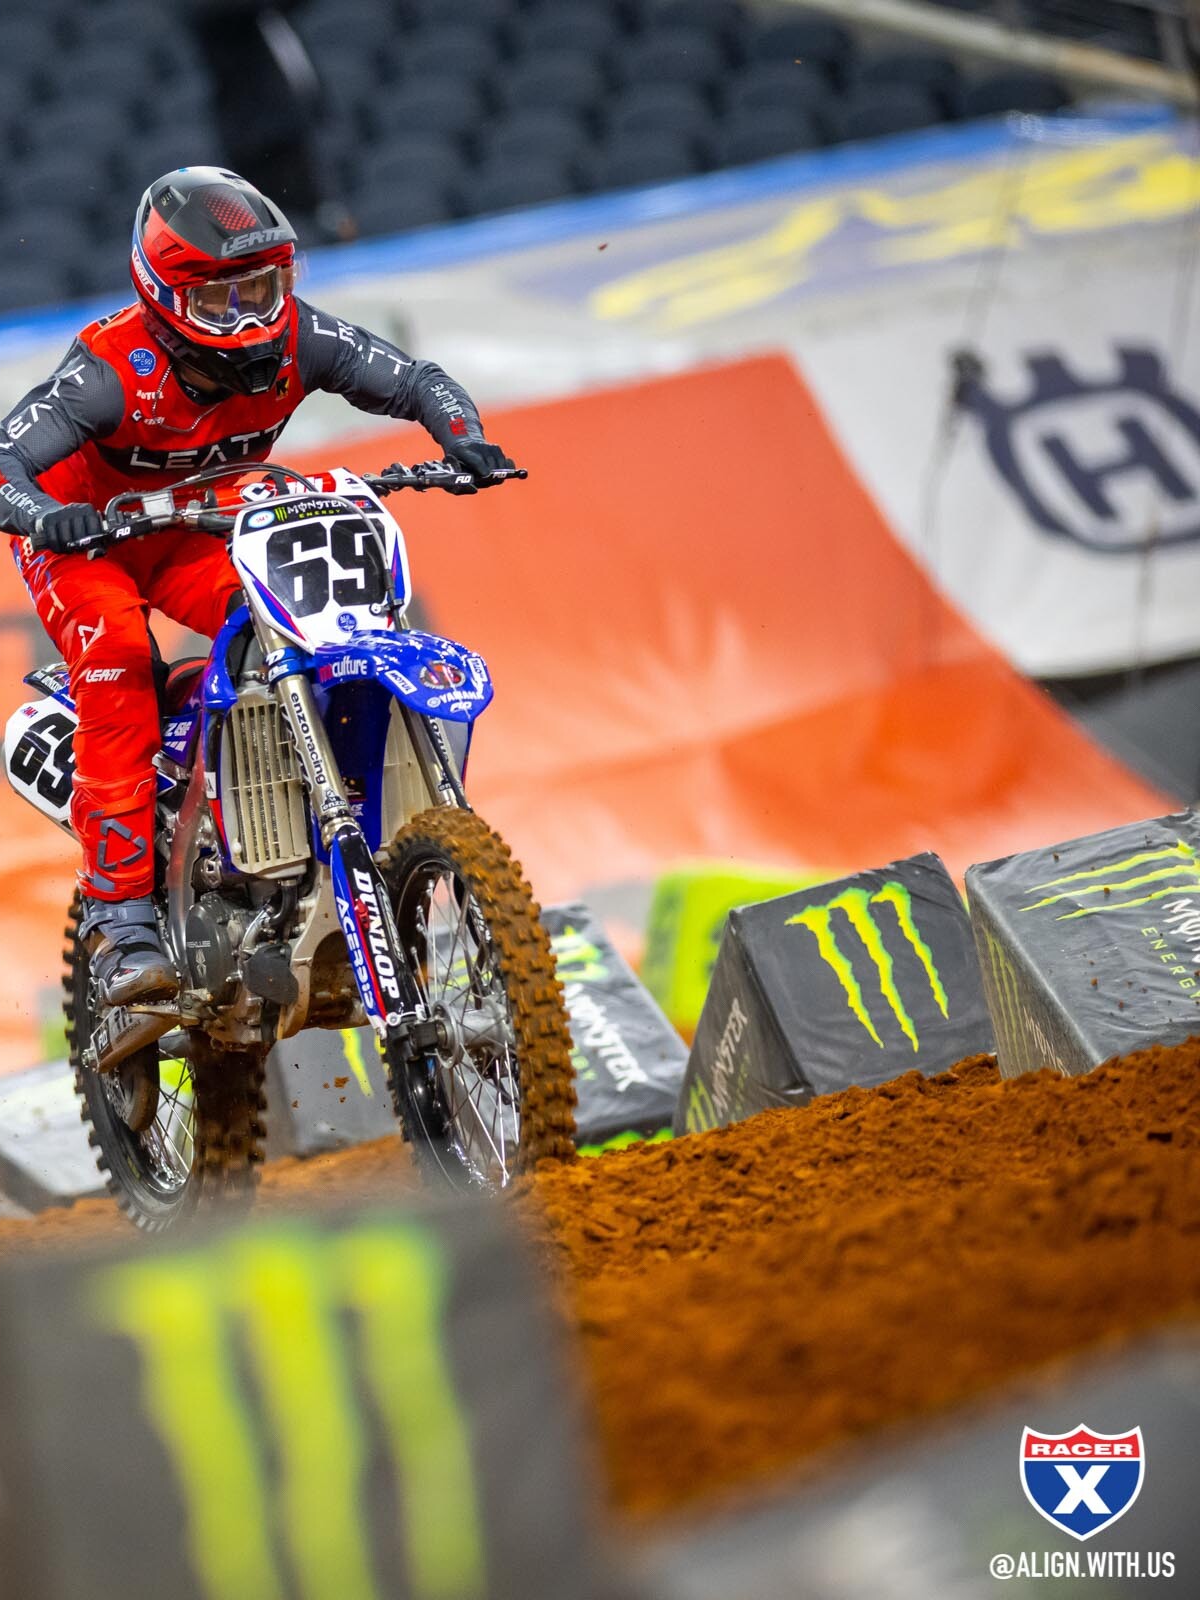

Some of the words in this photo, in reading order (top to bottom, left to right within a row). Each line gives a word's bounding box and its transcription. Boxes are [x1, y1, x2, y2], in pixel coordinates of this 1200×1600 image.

[221, 229, 286, 257] LEATT
[455, 475, 472, 484] FLO
[287, 499, 347, 515] MONSTER
[298, 509, 341, 518] ENERGY
[115, 526, 131, 538] FLO
[266, 518, 386, 618] 69
[86, 668, 126, 683] LEATT
[290, 692, 310, 737] enzo
[305, 735, 328, 785] racing
[352, 867, 400, 1000] DUNLOP
